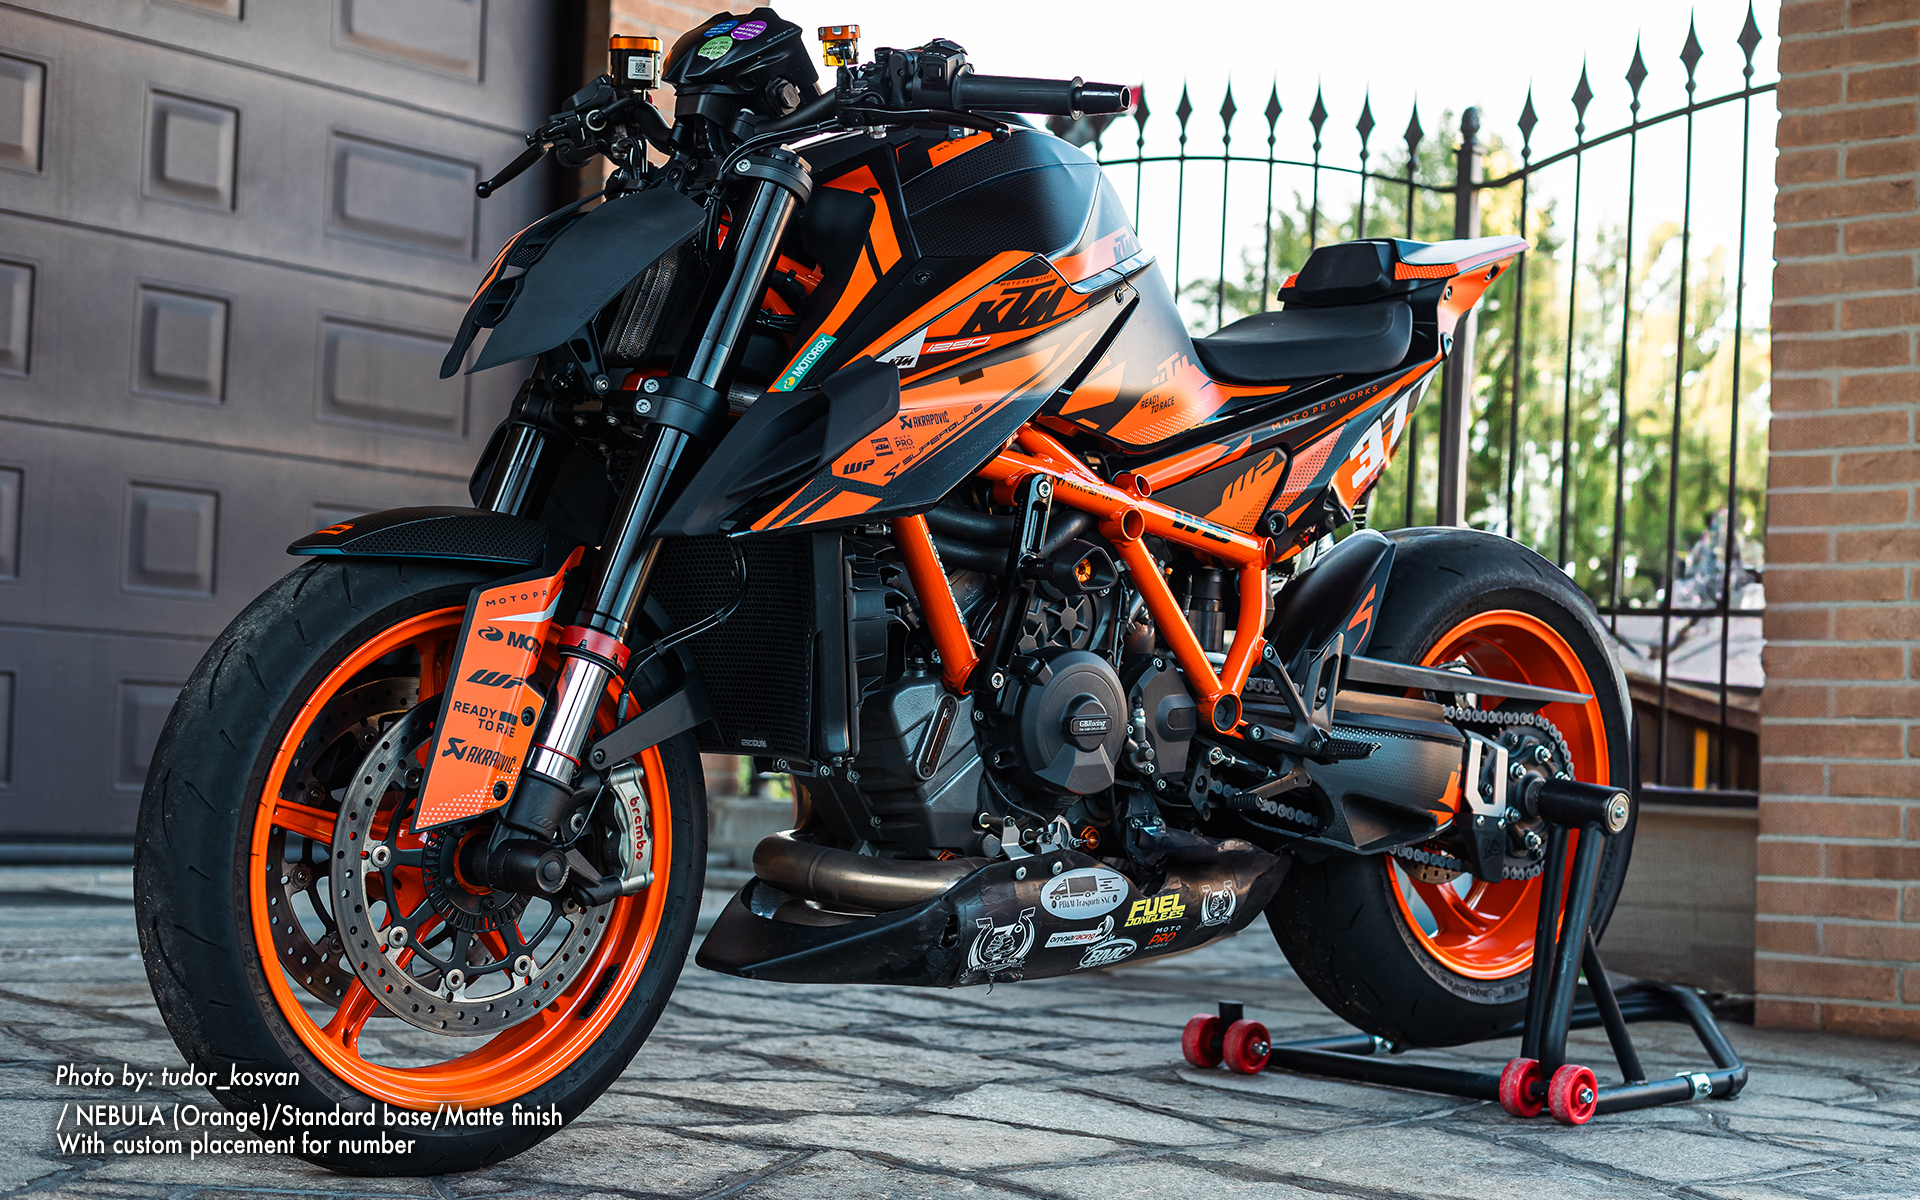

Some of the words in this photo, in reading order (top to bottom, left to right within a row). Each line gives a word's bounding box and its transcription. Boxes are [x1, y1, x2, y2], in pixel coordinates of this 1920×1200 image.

[956, 279, 1068, 337] KTM
[926, 336, 991, 353] 1290
[793, 336, 832, 379] MOTOREX
[1140, 393, 1160, 410] READY
[1151, 403, 1159, 415] TO
[1159, 396, 1174, 411] RACE
[895, 438, 914, 448] PRO
[842, 459, 875, 475] WP
[453, 700, 497, 719] READY
[478, 718, 494, 731] TO
[1079, 719, 1107, 727] GBRacing
[629, 796, 644, 861] brembo
[1128, 893, 1186, 918] FUEL
[1155, 924, 1182, 934] MOTO
[1147, 931, 1177, 946] PRO
